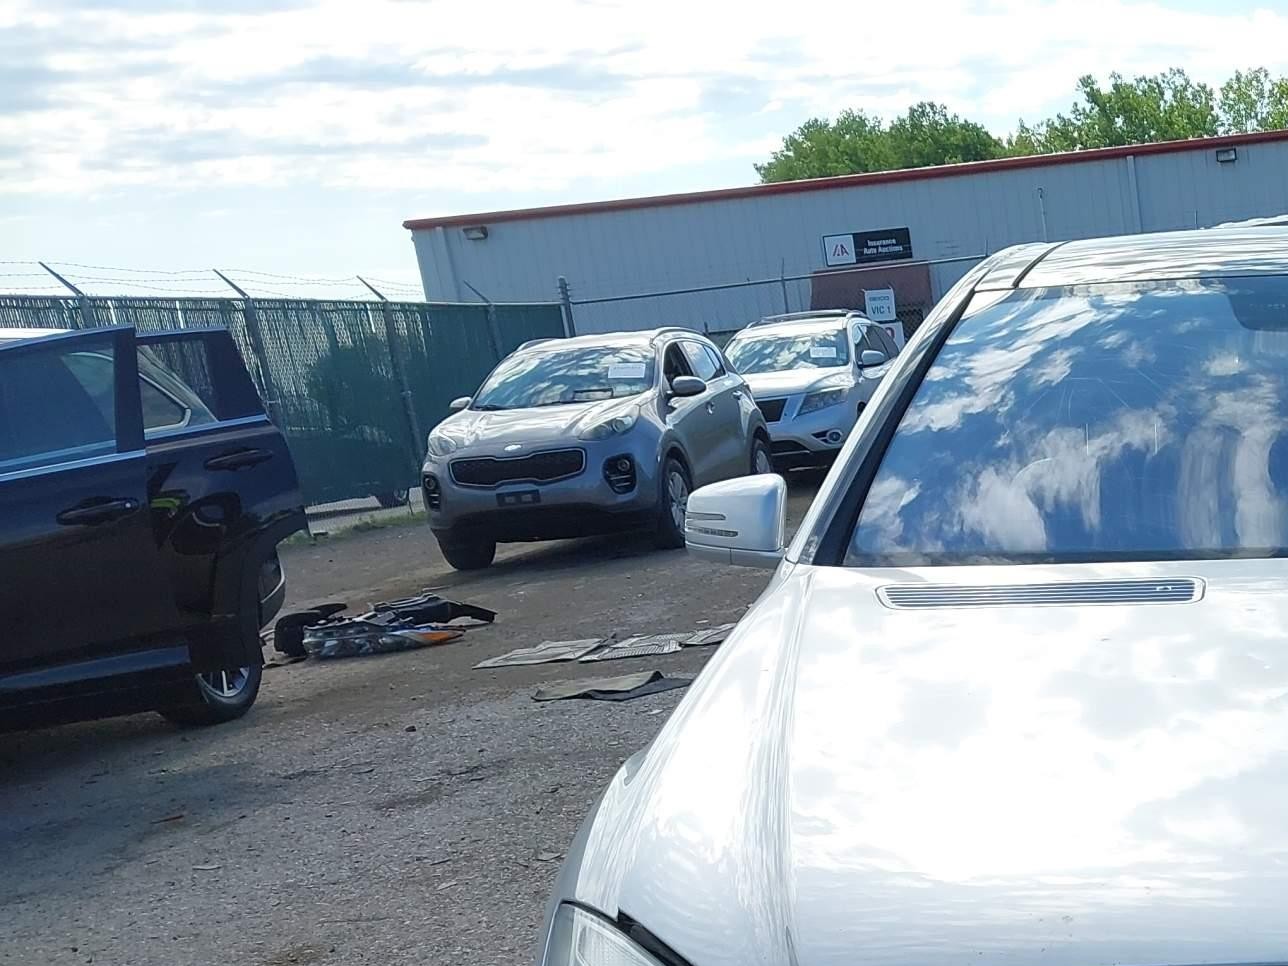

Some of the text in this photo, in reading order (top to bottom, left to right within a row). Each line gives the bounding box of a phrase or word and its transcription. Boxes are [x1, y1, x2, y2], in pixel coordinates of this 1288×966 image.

[867, 238, 897, 247] Insurance
[863, 245, 903, 255] Auto Auctions
[871, 305, 885, 315] VIC
